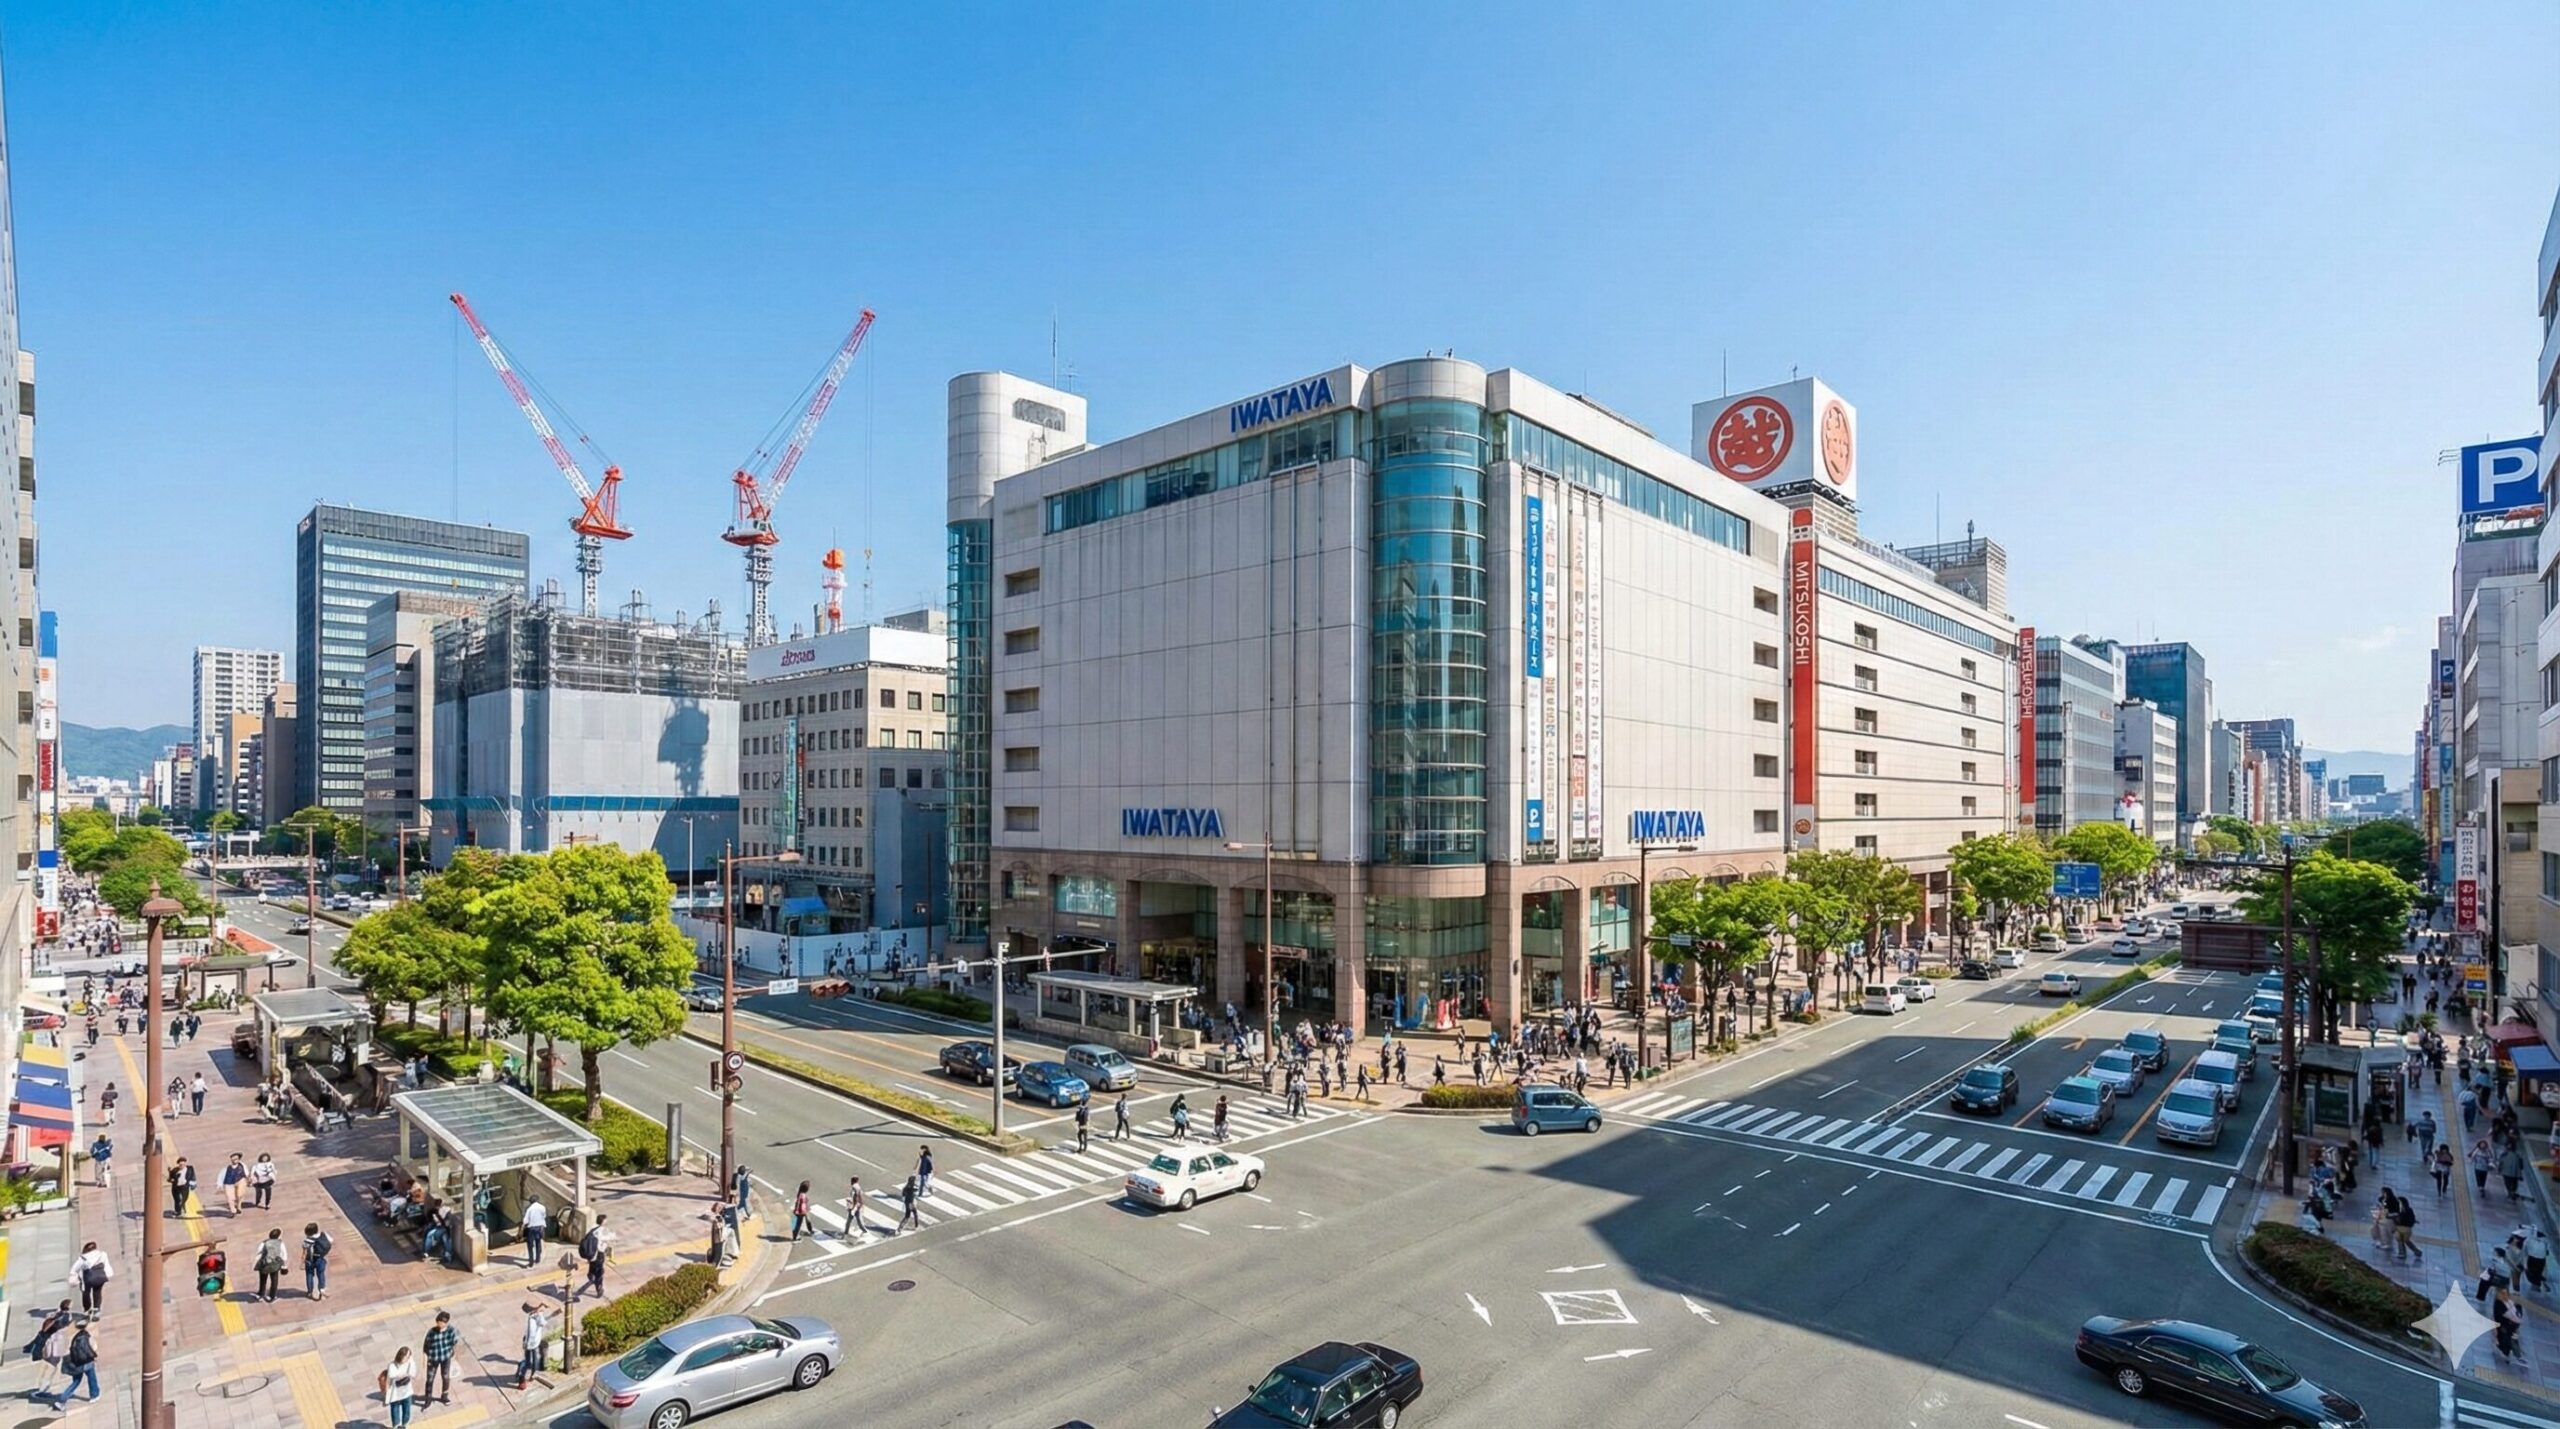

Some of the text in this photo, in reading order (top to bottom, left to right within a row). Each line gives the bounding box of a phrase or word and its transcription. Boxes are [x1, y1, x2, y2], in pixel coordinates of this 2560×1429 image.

[1231, 377, 1334, 433] IWATAYA
[2478, 447, 2538, 504] P
[1795, 561, 1810, 665] MITSUKOSHI
[1122, 808, 1224, 838] IWATAYA
[1634, 810, 1706, 838] IWATAYA
